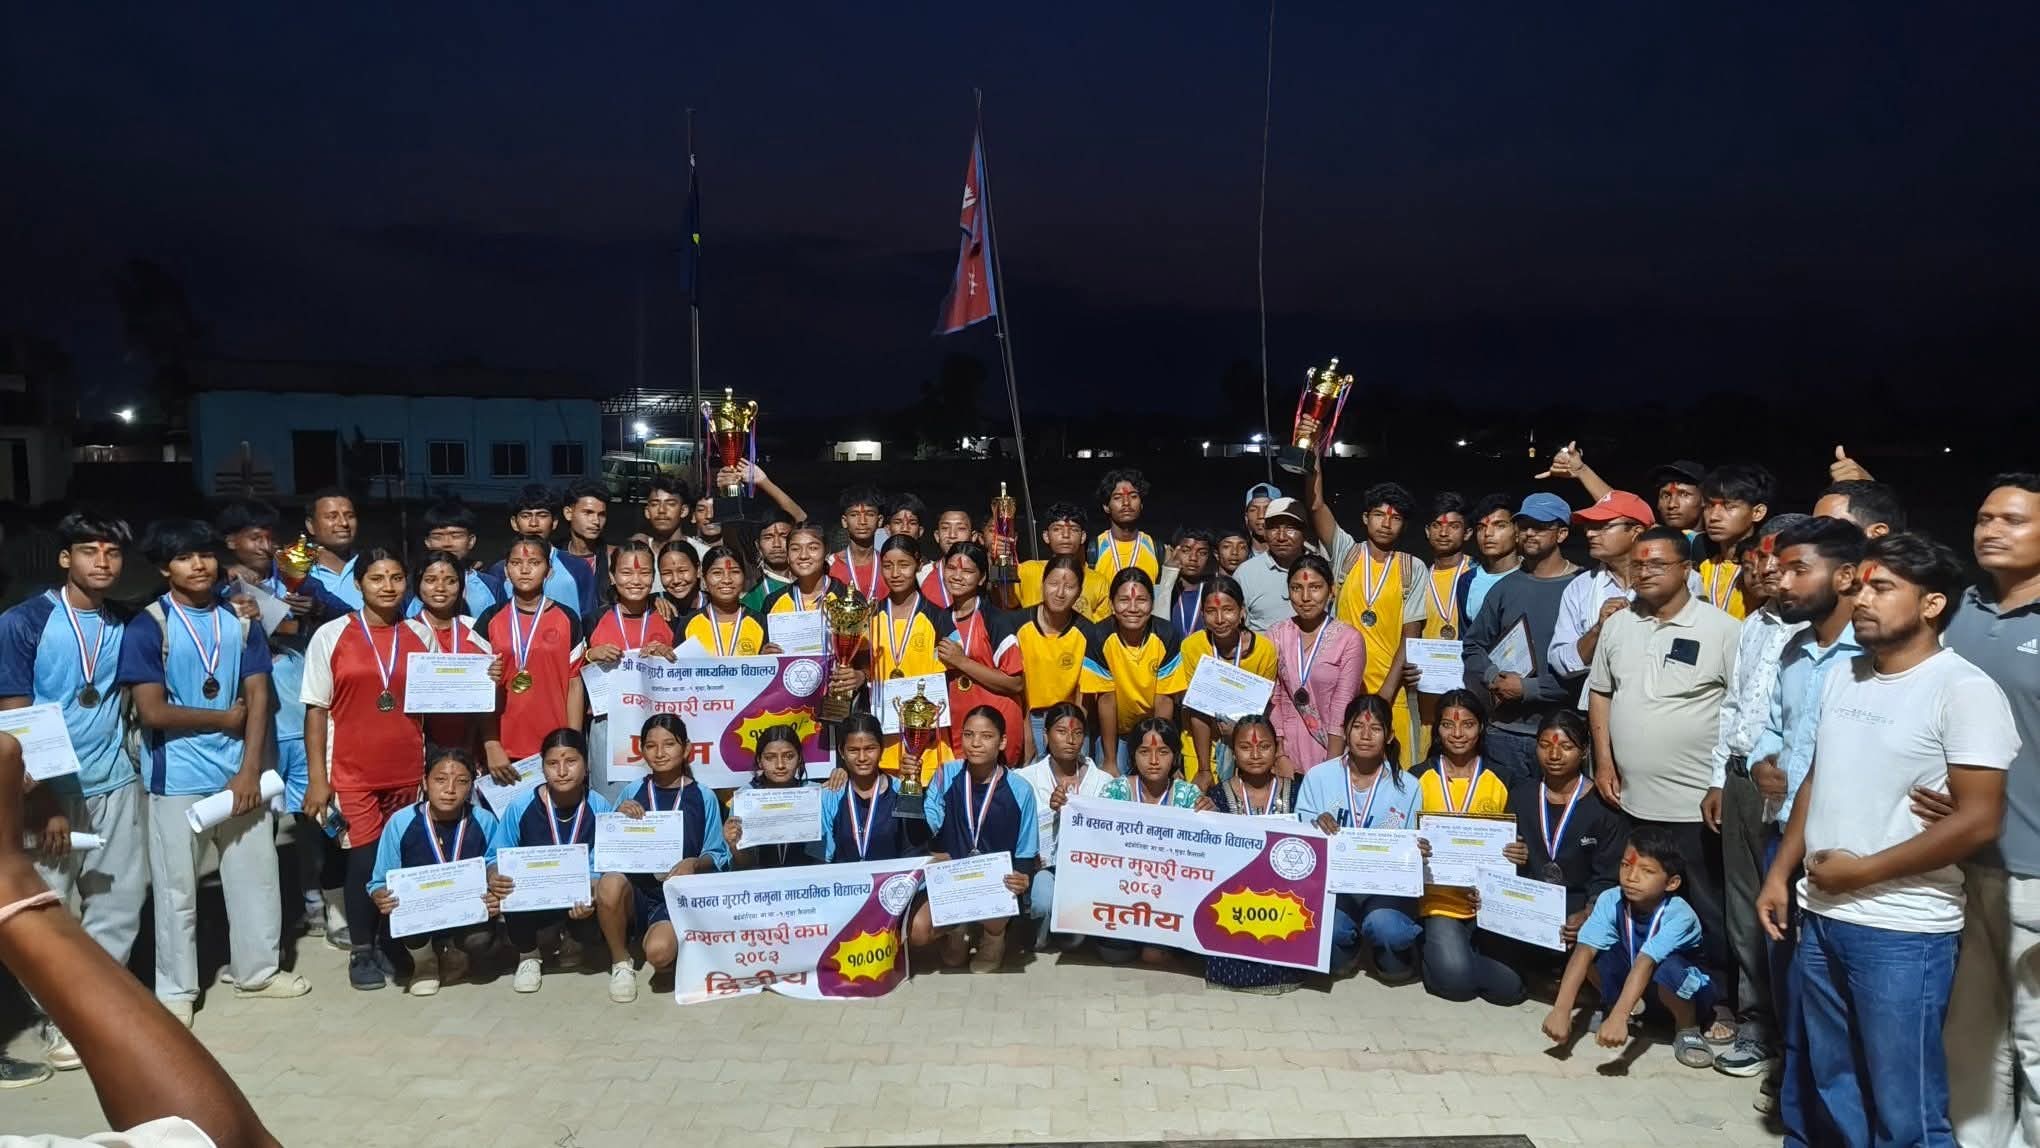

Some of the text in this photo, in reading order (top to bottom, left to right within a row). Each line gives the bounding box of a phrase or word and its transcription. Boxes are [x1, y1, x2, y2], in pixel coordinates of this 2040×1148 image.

[666, 667, 692, 680] नमुना
[695, 664, 738, 678] माध्यमिक
[741, 663, 777, 678] विद्यालय
[702, 699, 735, 711] कप
[1071, 813, 1264, 850] श्री बसन्त मुरारी नमुना माध्यमिक विद्यालय
[1070, 850, 1216, 882] बसन्त मुरारी कप
[677, 895, 688, 909] श्री
[690, 895, 719, 909] बसन्त
[753, 890, 782, 906] नमुना
[784, 883, 831, 900] माध्यमिक
[833, 882, 871, 897] विद्यालय
[1118, 879, 1162, 898] २०८३
[1092, 901, 1184, 932] तृतीय
[684, 923, 829, 947] बसन्त मुरारी कप
[734, 951, 780, 967] २०८३
